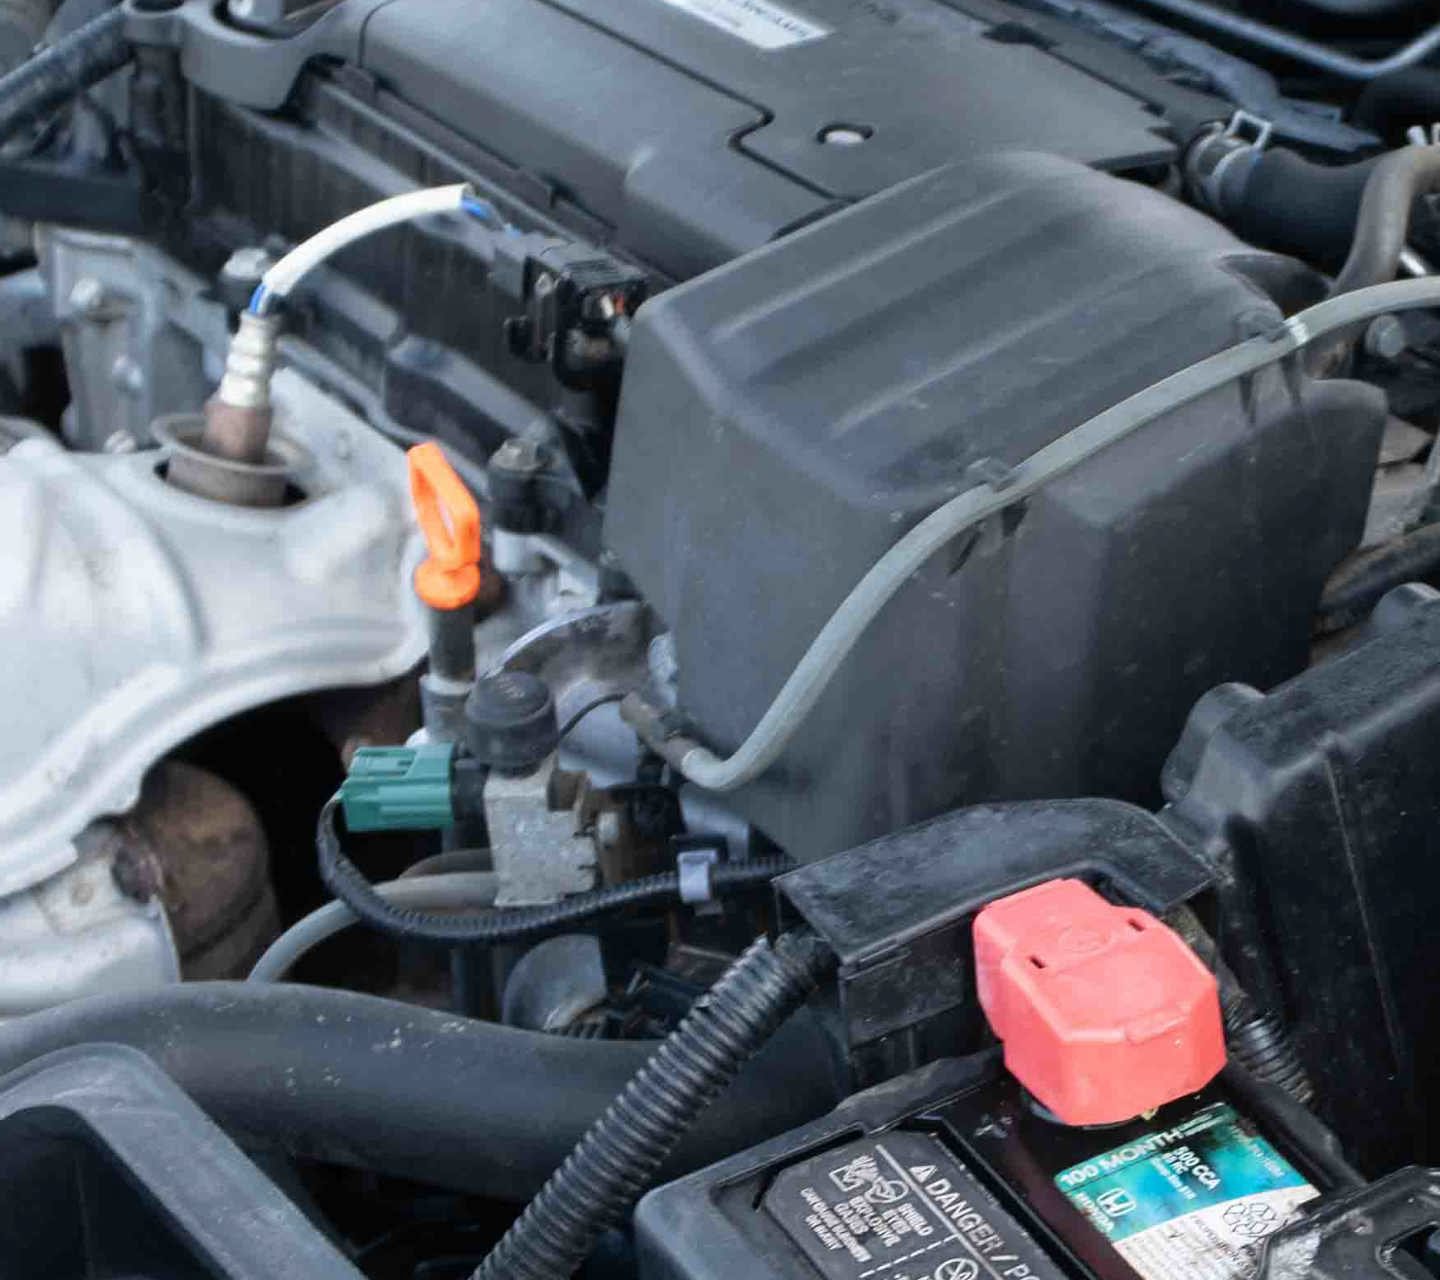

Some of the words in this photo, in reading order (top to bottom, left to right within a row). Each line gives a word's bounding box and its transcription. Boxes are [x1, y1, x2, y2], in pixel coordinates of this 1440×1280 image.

[1058, 1162, 1101, 1187] 100
[1095, 1126, 1186, 1171] MONTH
[1188, 1163, 1224, 1190] CCA
[831, 1201, 870, 1235] GASES
[846, 1195, 902, 1247] EXPLOSIVE
[922, 1178, 1006, 1253] DANGER
[1074, 1190, 1116, 1232] HONDA
